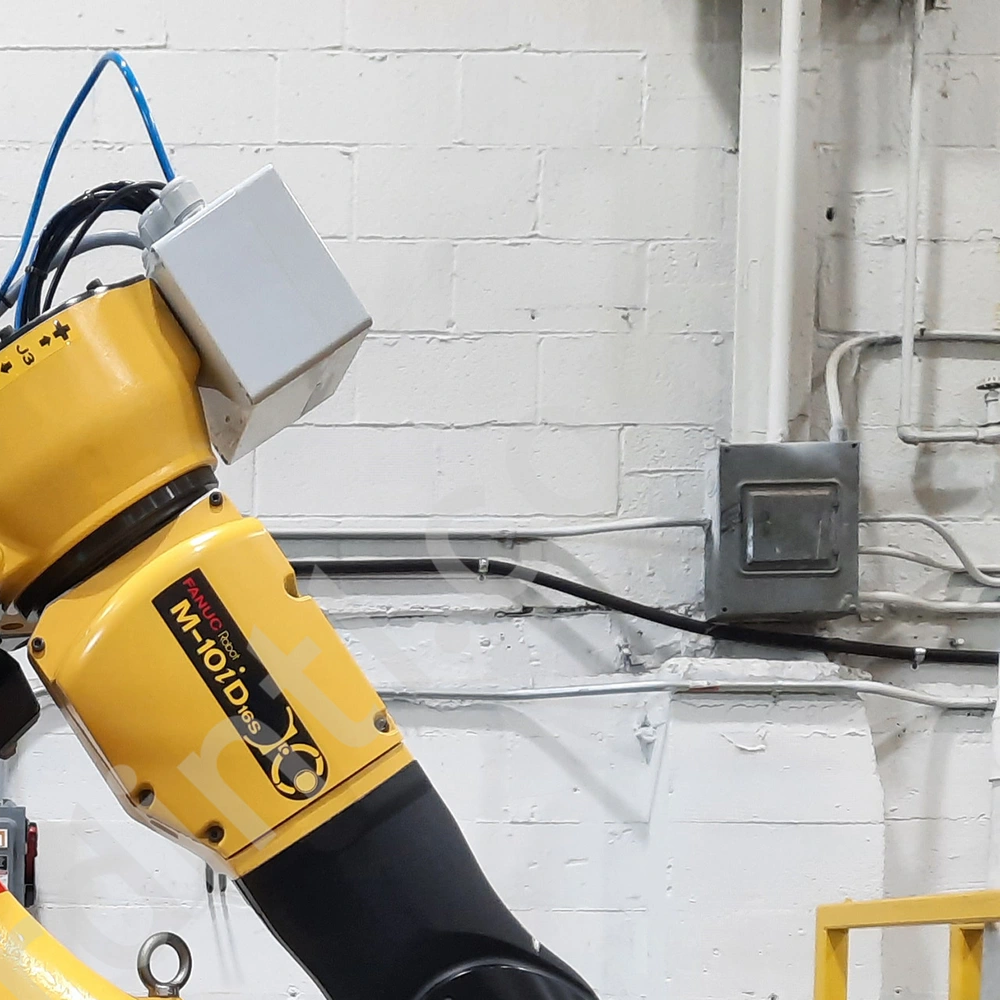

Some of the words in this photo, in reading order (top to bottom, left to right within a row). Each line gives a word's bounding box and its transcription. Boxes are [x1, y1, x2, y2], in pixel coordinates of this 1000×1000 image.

[16, 345, 35, 366] J3
[182, 577, 223, 632] FANUC
[217, 630, 240, 661] Robot
